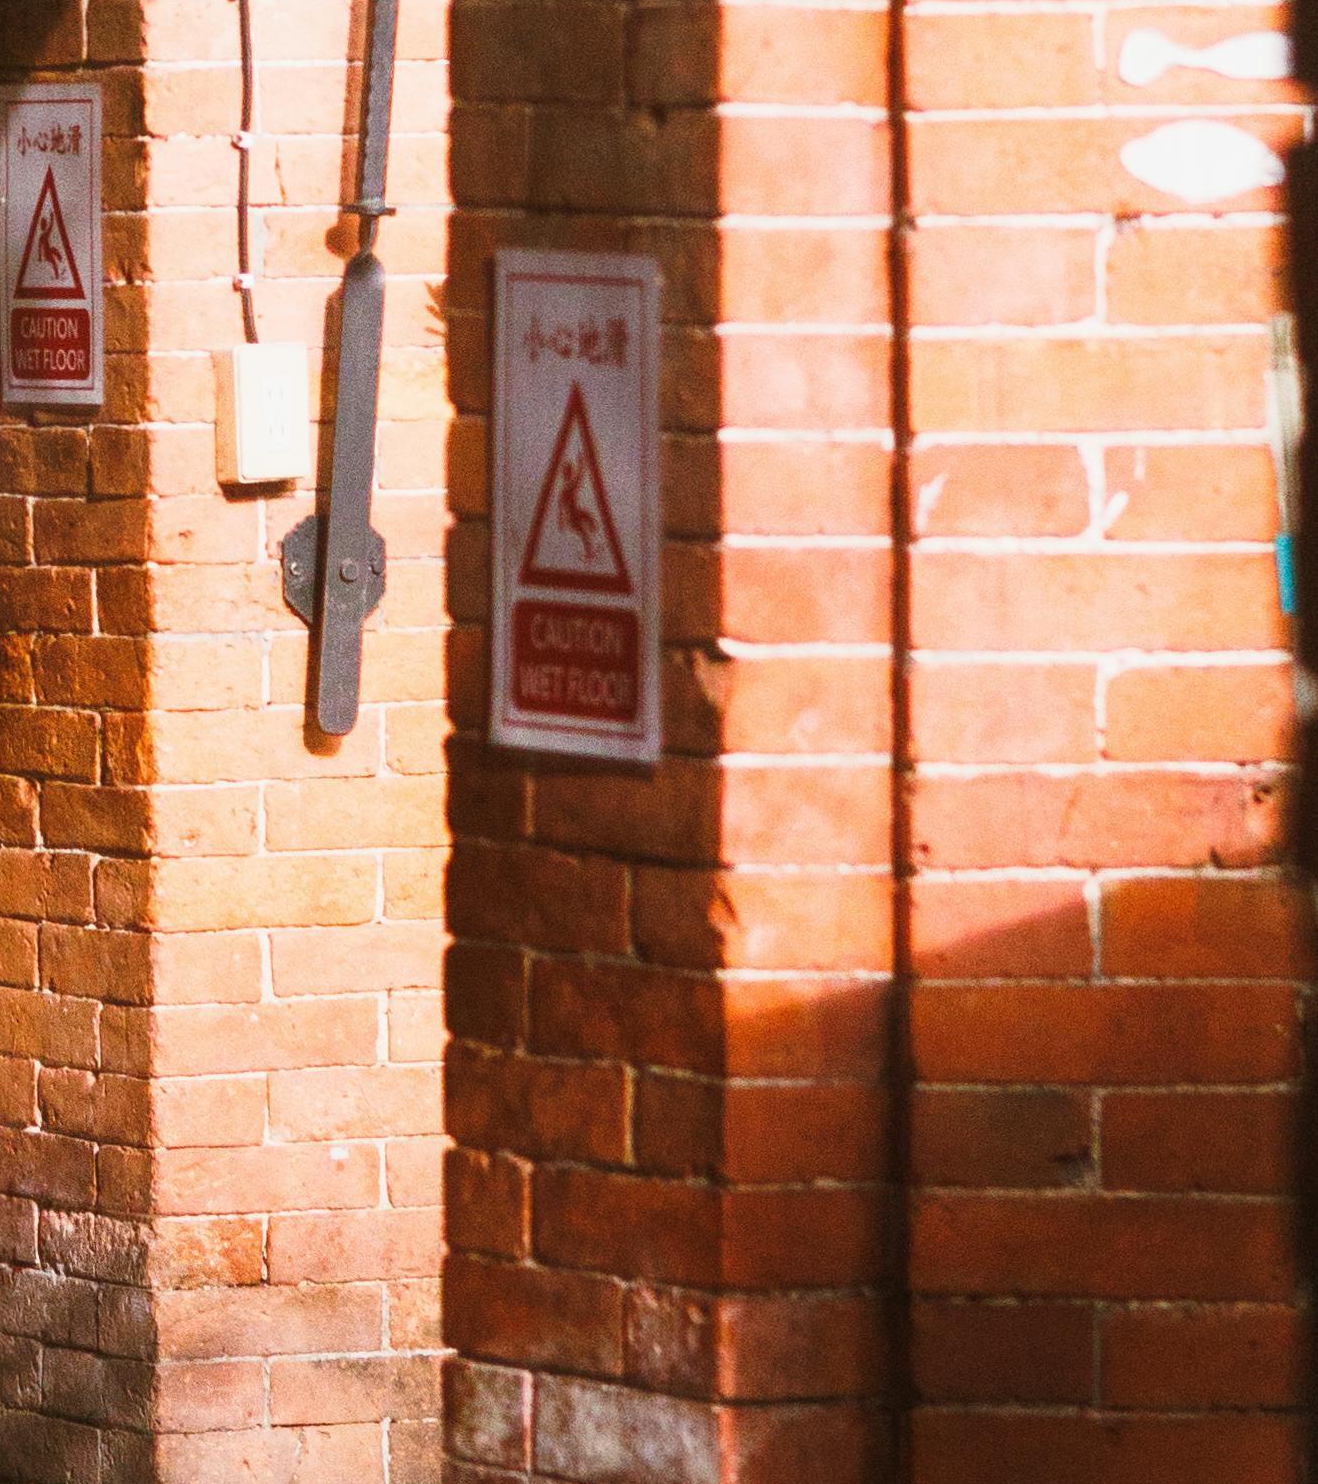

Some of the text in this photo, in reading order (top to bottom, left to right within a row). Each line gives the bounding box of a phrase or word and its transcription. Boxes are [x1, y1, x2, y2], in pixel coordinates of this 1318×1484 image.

[16, 124, 81, 156] 小心地滑
[20, 317, 79, 339] CAUTION
[524, 316, 628, 368] 小心地滑
[16, 349, 85, 371] WET FLOOR
[530, 612, 622, 655] CAUTION
